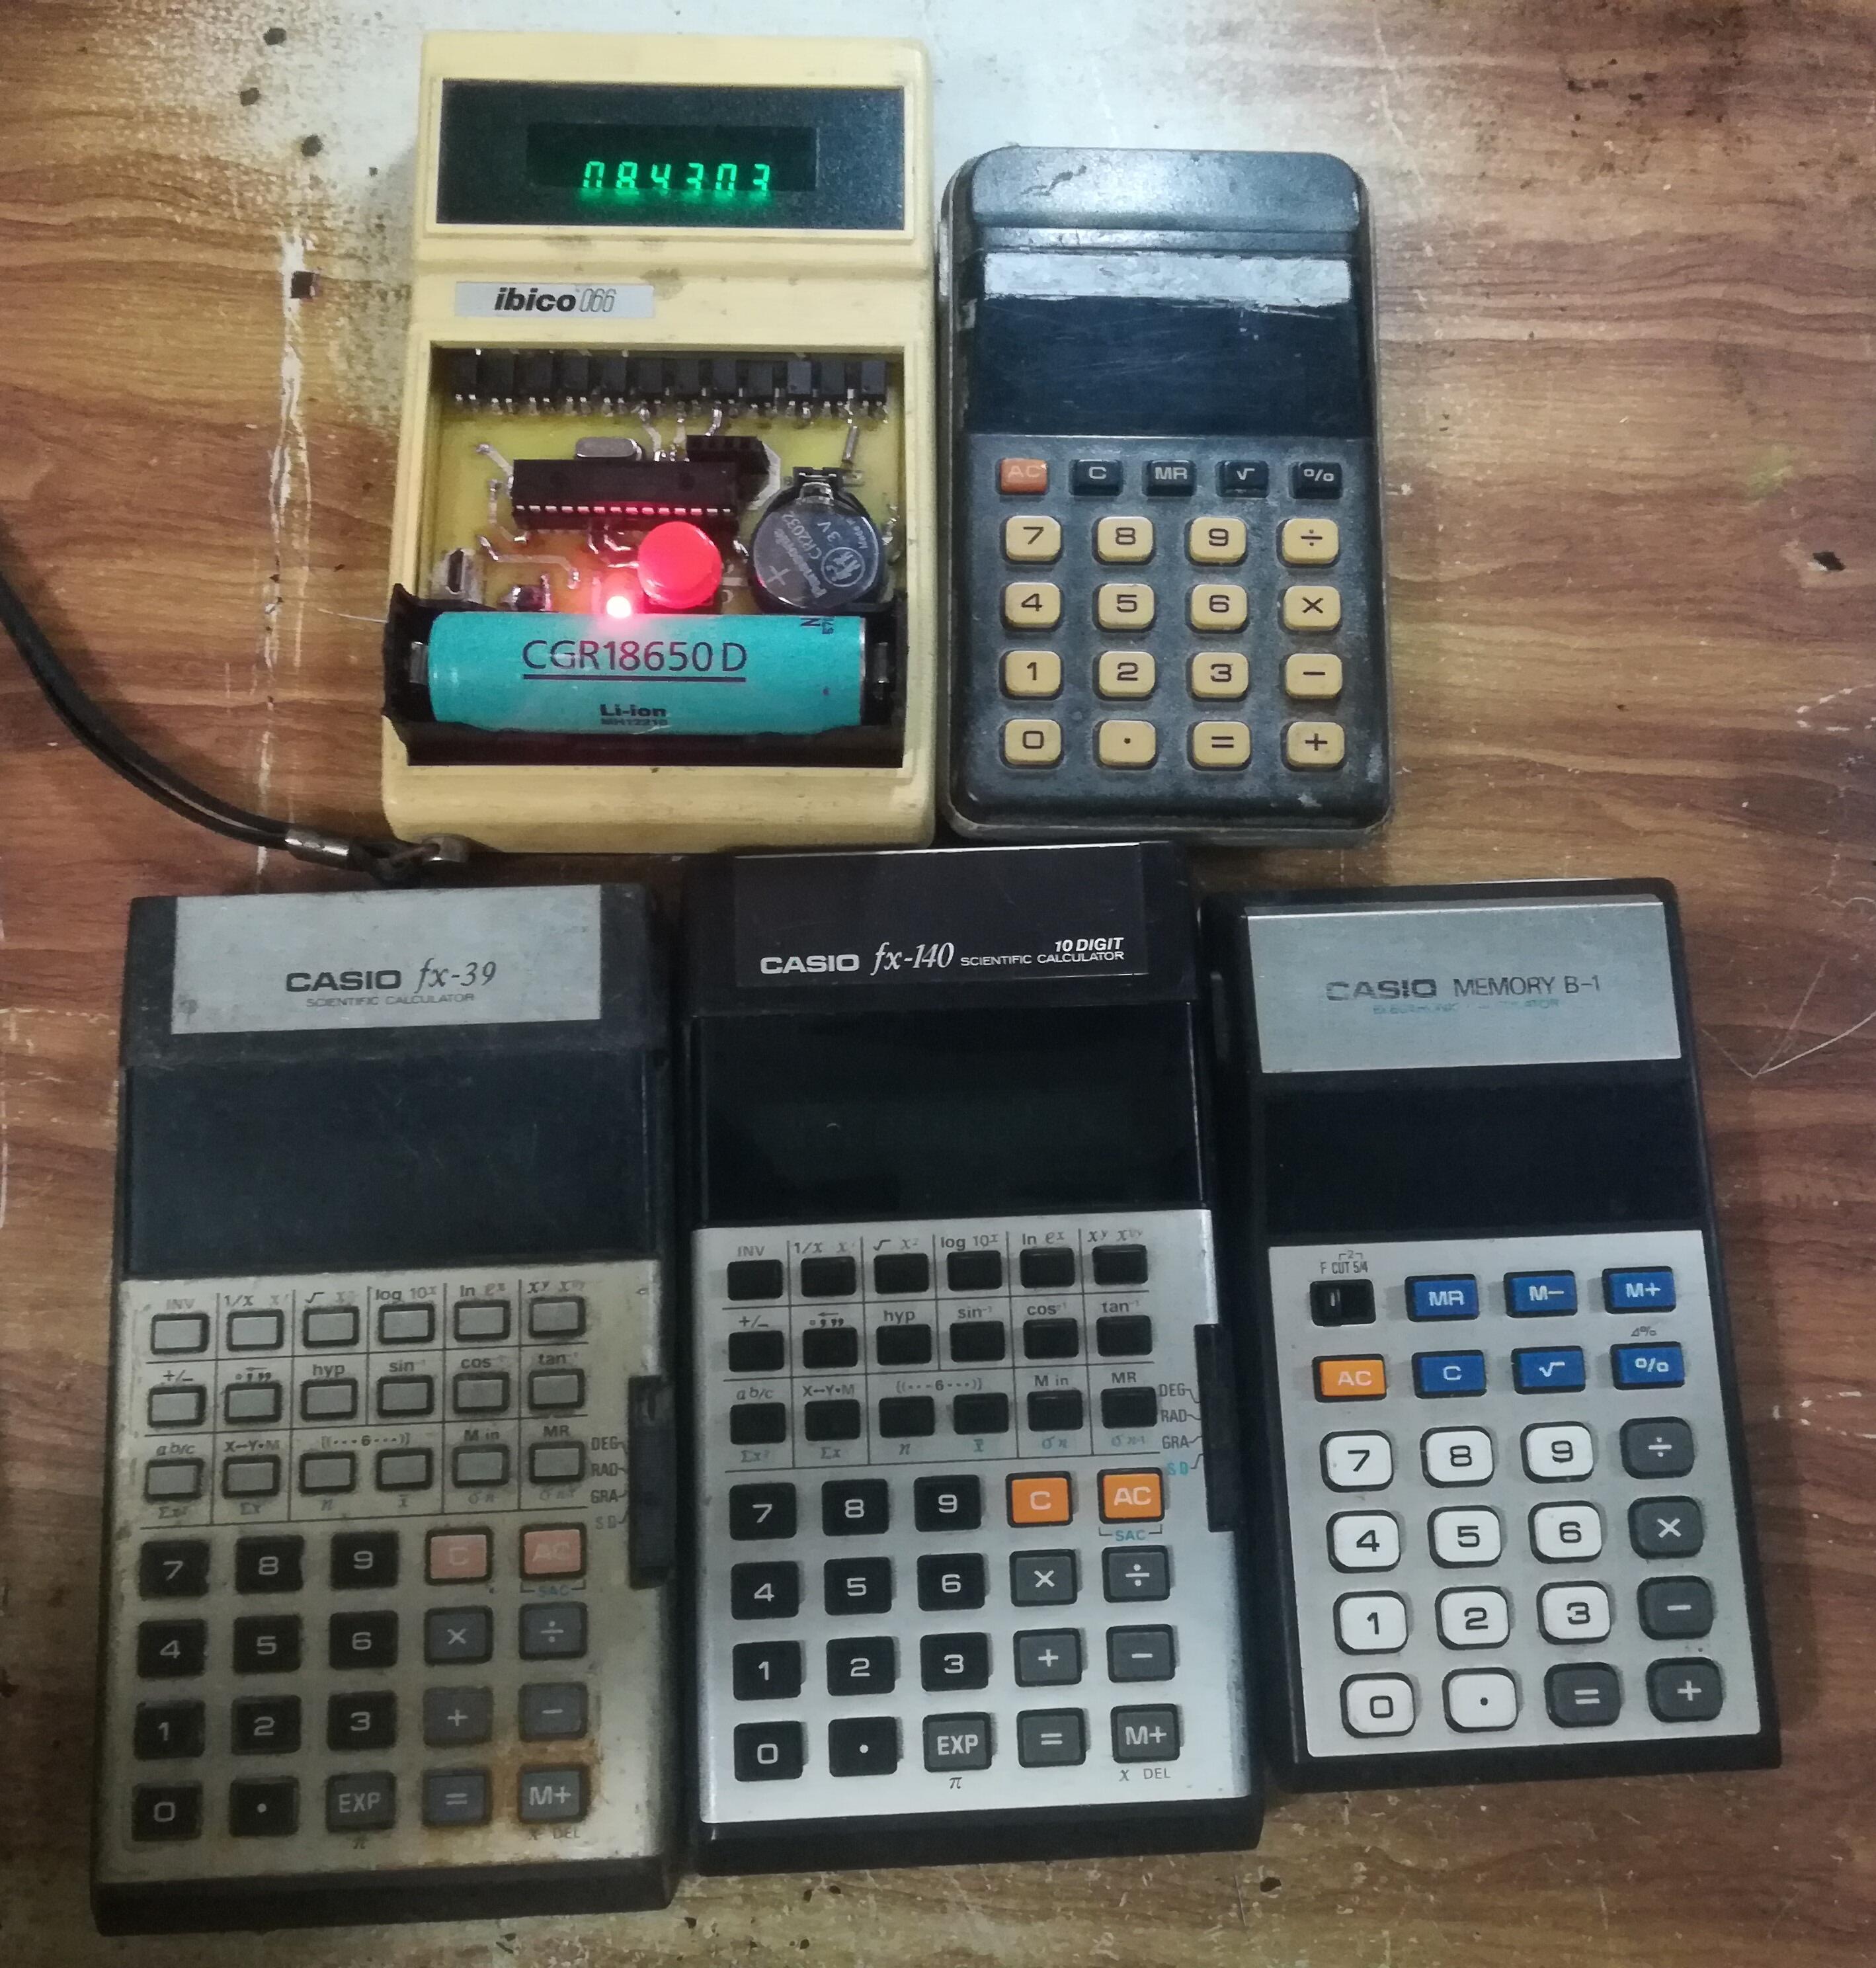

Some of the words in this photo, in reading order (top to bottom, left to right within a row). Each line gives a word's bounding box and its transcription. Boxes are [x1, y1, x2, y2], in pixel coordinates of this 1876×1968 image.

[494, 287, 576, 311] ibico
[1008, 466, 1041, 478] AC
[1088, 466, 1107, 479] C
[1155, 466, 1188, 480] MR
[1023, 526, 1044, 545] 7
[1115, 526, 1137, 546] 8
[1208, 528, 1229, 547] 9
[1020, 593, 1043, 612] 4
[1116, 594, 1138, 613] 5
[1209, 594, 1230, 613] 6
[1026, 661, 1037, 681] 1
[1116, 662, 1139, 682] 2
[1210, 663, 1232, 682] 3
[599, 704, 667, 717] Li-ion
[1055, 940, 1073, 952] 10
[1075, 938, 1124, 952] DIGIT
[760, 954, 860, 975] CASIO
[870, 942, 955, 976] fx-140
[961, 955, 1032, 967] SCIENTIFIC
[1037, 952, 1125, 964] CALCULATOR
[286, 970, 401, 992] CASIO
[415, 958, 497, 993] fx-39
[1326, 979, 1437, 1000] CASIO
[1453, 976, 1555, 997] MEMORY
[1565, 975, 1601, 993] B-1
[307, 997, 380, 1007] SCIENTIFIC
[386, 993, 474, 1005] CALCULATOR
[737, 1246, 765, 1256] INV
[940, 1237, 965, 1250] log
[1332, 1262, 1350, 1274] CUT
[375, 1290, 402, 1301] log
[1428, 1290, 1465, 1307] MR
[883, 1310, 915, 1324] hyp
[313, 1364, 345, 1377] hyp
[1112, 1372, 1136, 1383] MR
[1338, 1370, 1371, 1386] AC
[1443, 1366, 1462, 1381] C
[1159, 1383, 1185, 1397] DEG
[1161, 1409, 1187, 1422] RAD
[544, 1425, 570, 1437] MR
[591, 1436, 618, 1450] DEG
[1162, 1436, 1189, 1449] GRA
[1551, 1440, 1574, 1463] 9
[1347, 1449, 1370, 1472] 7
[1449, 1445, 1473, 1467] 8
[592, 1463, 618, 1476] RAD
[591, 1489, 618, 1503] GRA
[938, 1494, 958, 1514] 9
[1030, 1491, 1051, 1510] C
[1114, 1487, 1151, 1506] AC
[753, 1503, 773, 1523] 7
[844, 1498, 865, 1518] 8
[1116, 1530, 1146, 1541] SAC
[1356, 1530, 1380, 1553] 4
[1457, 1525, 1481, 1548] 5
[1559, 1521, 1582, 1543] 6
[353, 1550, 374, 1570] 9
[449, 1547, 469, 1565] C
[532, 1542, 570, 1561] AC
[163, 1560, 184, 1580] 7
[258, 1555, 279, 1576] 8
[754, 1582, 775, 1602] 4
[846, 1577, 867, 1596] 5
[942, 1573, 961, 1593] 6
[1464, 1607, 1489, 1631] 2
[1567, 1602, 1591, 1625] 3
[1366, 1612, 1379, 1635] 1
[159, 1639, 181, 1659] 4
[256, 1635, 277, 1655] 5
[352, 1631, 372, 1651] 6
[758, 1661, 769, 1681] 1
[850, 1657, 870, 1677] 2
[944, 1654, 964, 1674] 3
[253, 1716, 275, 1737] 2
[350, 1711, 371, 1731] 3
[158, 1721, 169, 1741] 1
[1125, 1725, 1167, 1745] M+
[937, 1734, 979, 1756] EXP
[1143, 1767, 1170, 1780] DEL
[339, 1791, 381, 1813] EXP
